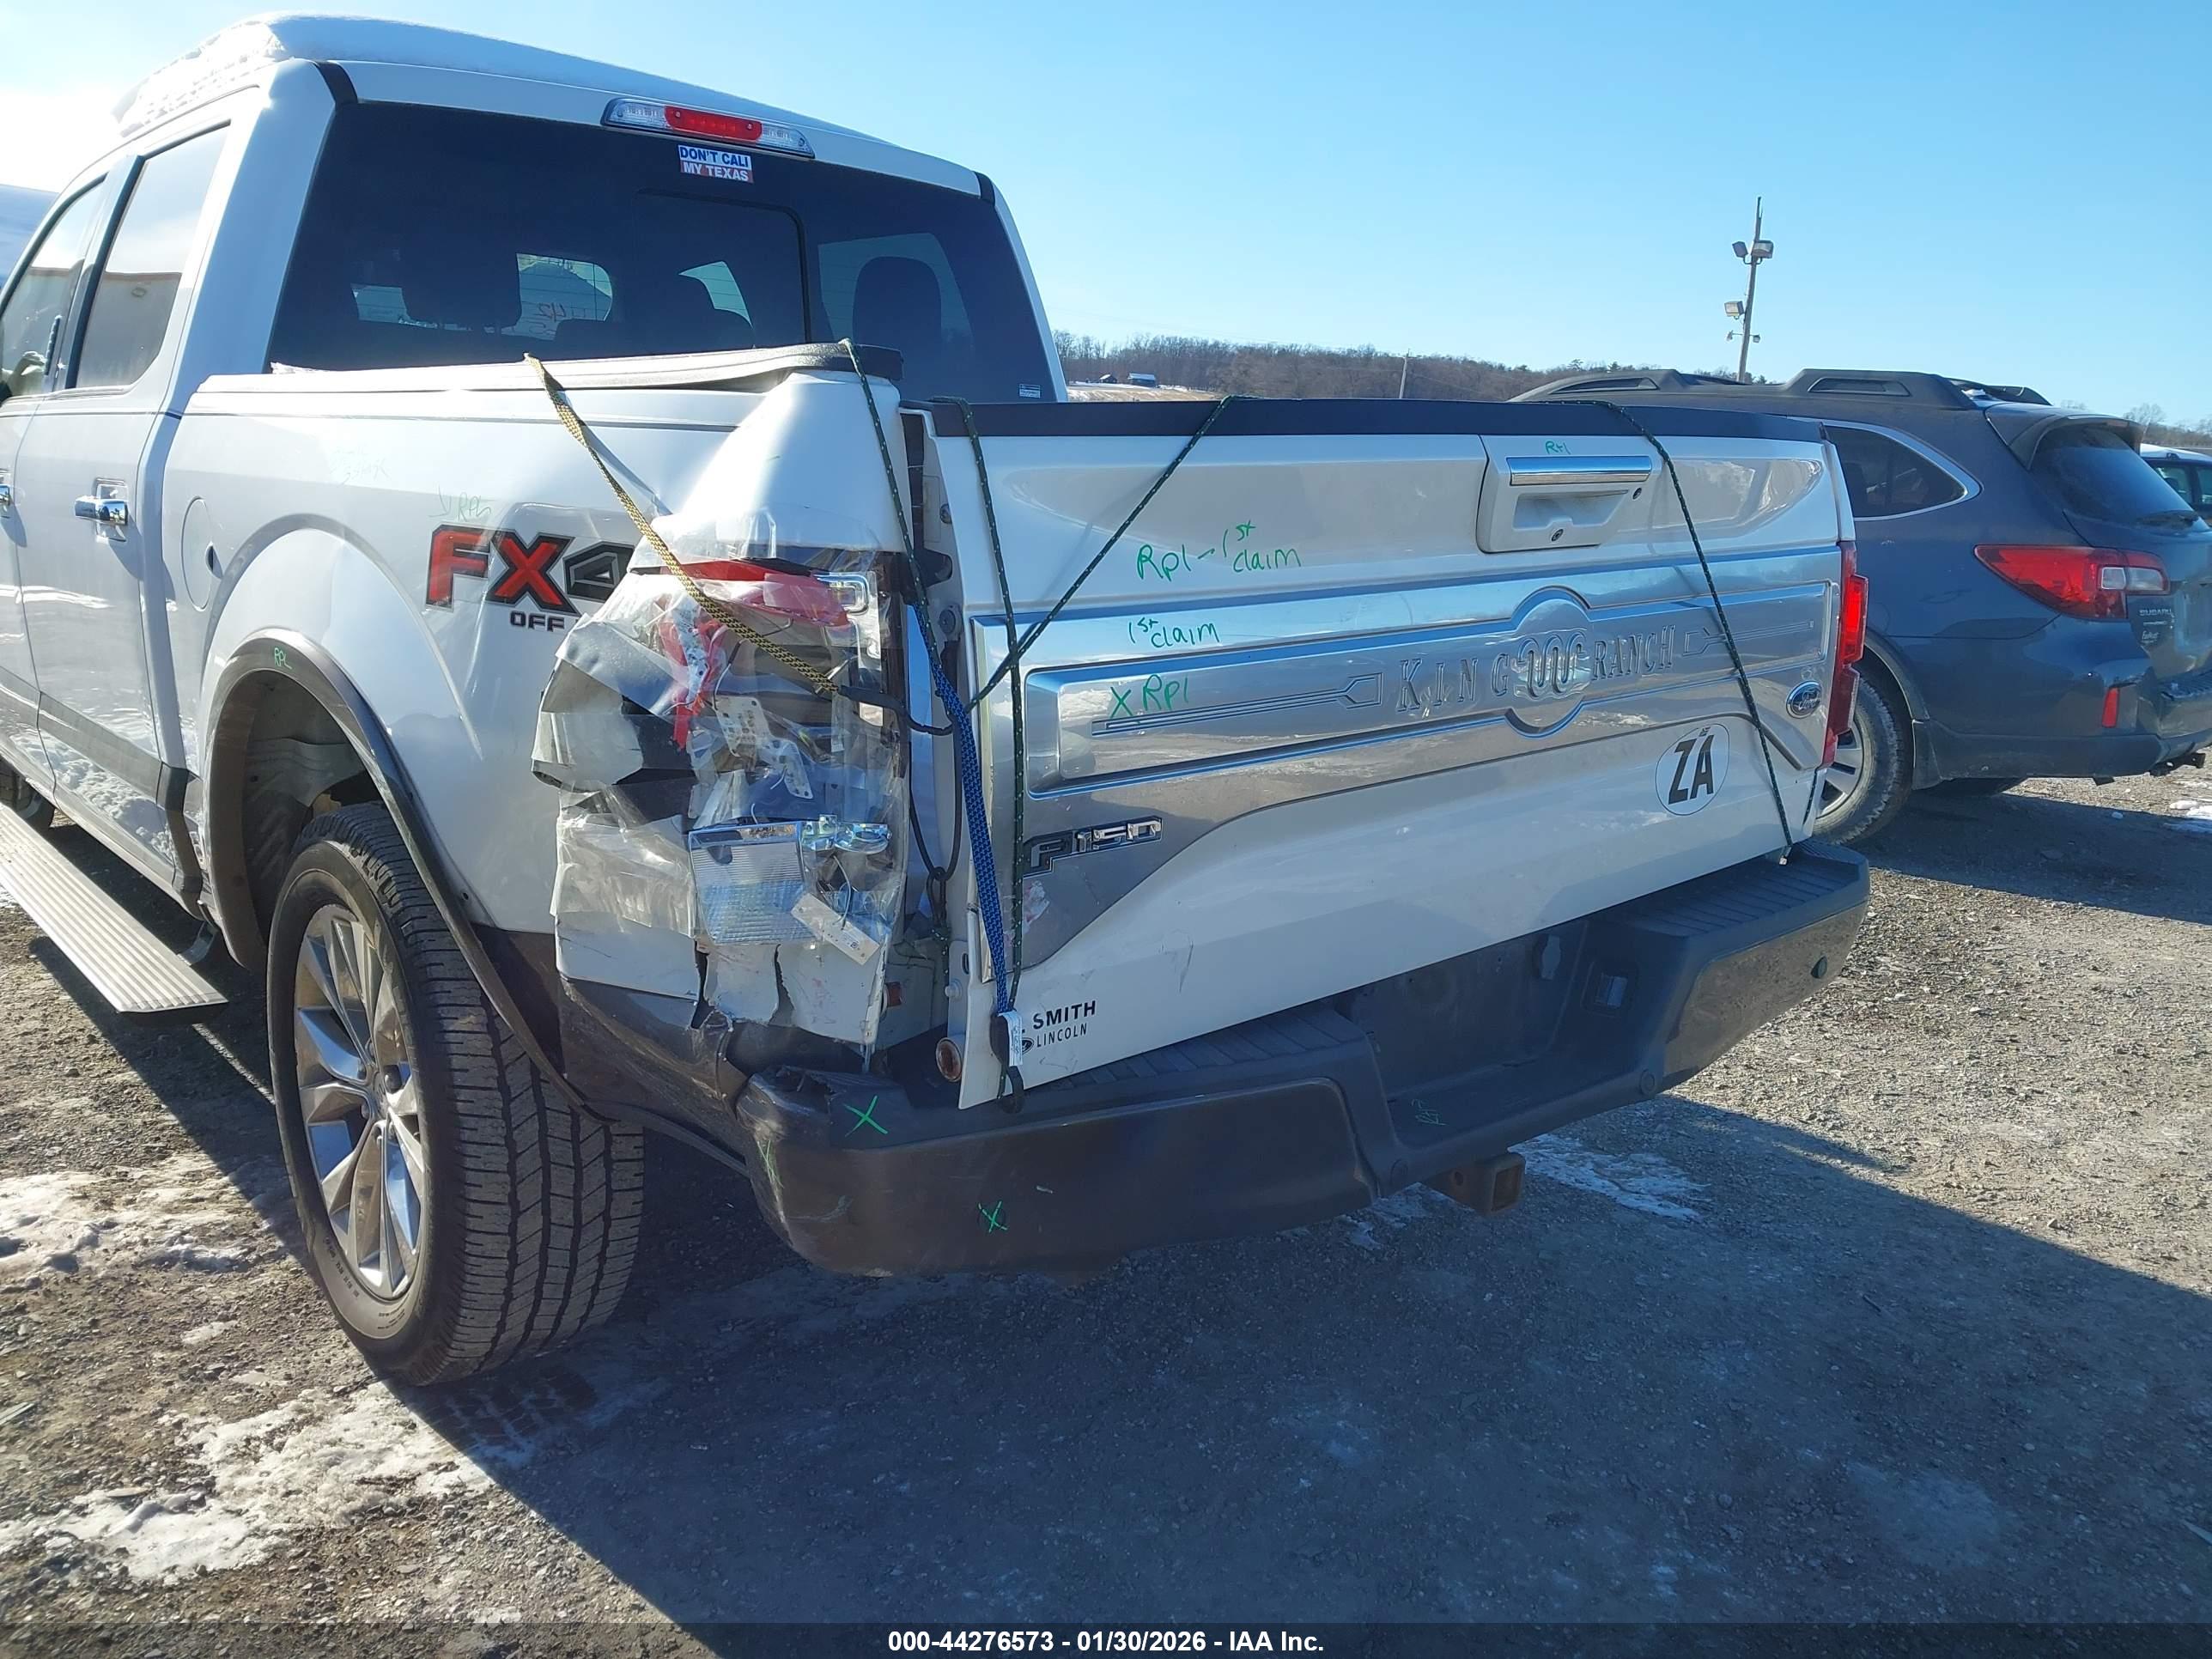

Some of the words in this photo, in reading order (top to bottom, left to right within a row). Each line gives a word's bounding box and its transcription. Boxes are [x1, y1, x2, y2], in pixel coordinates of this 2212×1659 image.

[680, 146, 718, 163] DON'T
[722, 153, 749, 167] CALI
[684, 161, 702, 175] MY
[705, 165, 749, 182] TEXAS
[427, 524, 635, 616] FX4
[1232, 548, 1302, 574] claim
[509, 611, 565, 632] OFF
[1151, 623, 1220, 648] claim
[1396, 652, 1510, 713] KING
[1590, 624, 1676, 681] RANCH
[1668, 734, 1715, 805] ZA
[1033, 1000, 1096, 1030] SMITH
[1036, 1022, 1087, 1048] LINCOLN
